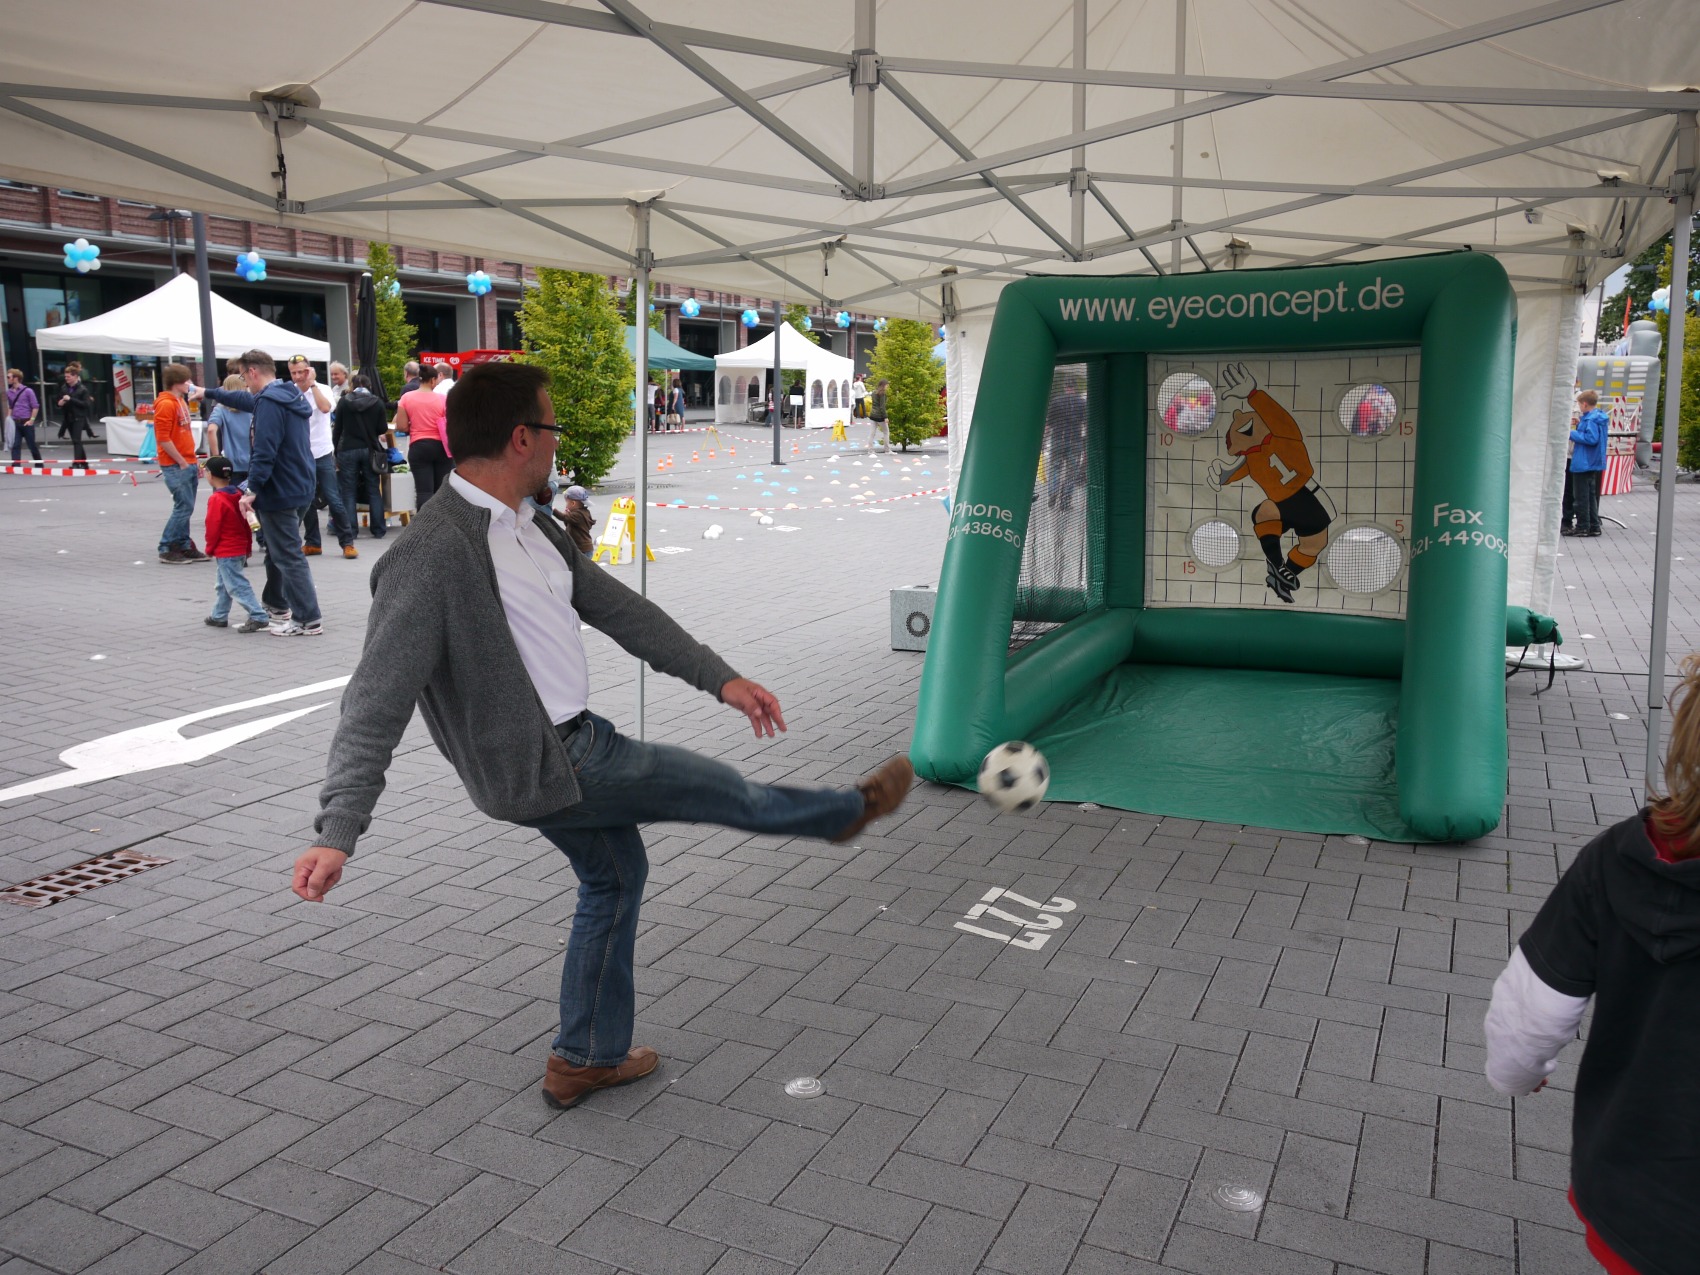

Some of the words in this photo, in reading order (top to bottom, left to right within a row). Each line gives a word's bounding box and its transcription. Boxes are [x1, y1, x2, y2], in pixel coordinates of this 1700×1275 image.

[1399, 422, 1414, 435] 15
[1160, 433, 1174, 446] 10
[1269, 453, 1298, 486] 1
[1433, 503, 1484, 527] Fax
[1395, 520, 1404, 533] 5
[1183, 561, 1196, 574] 15
